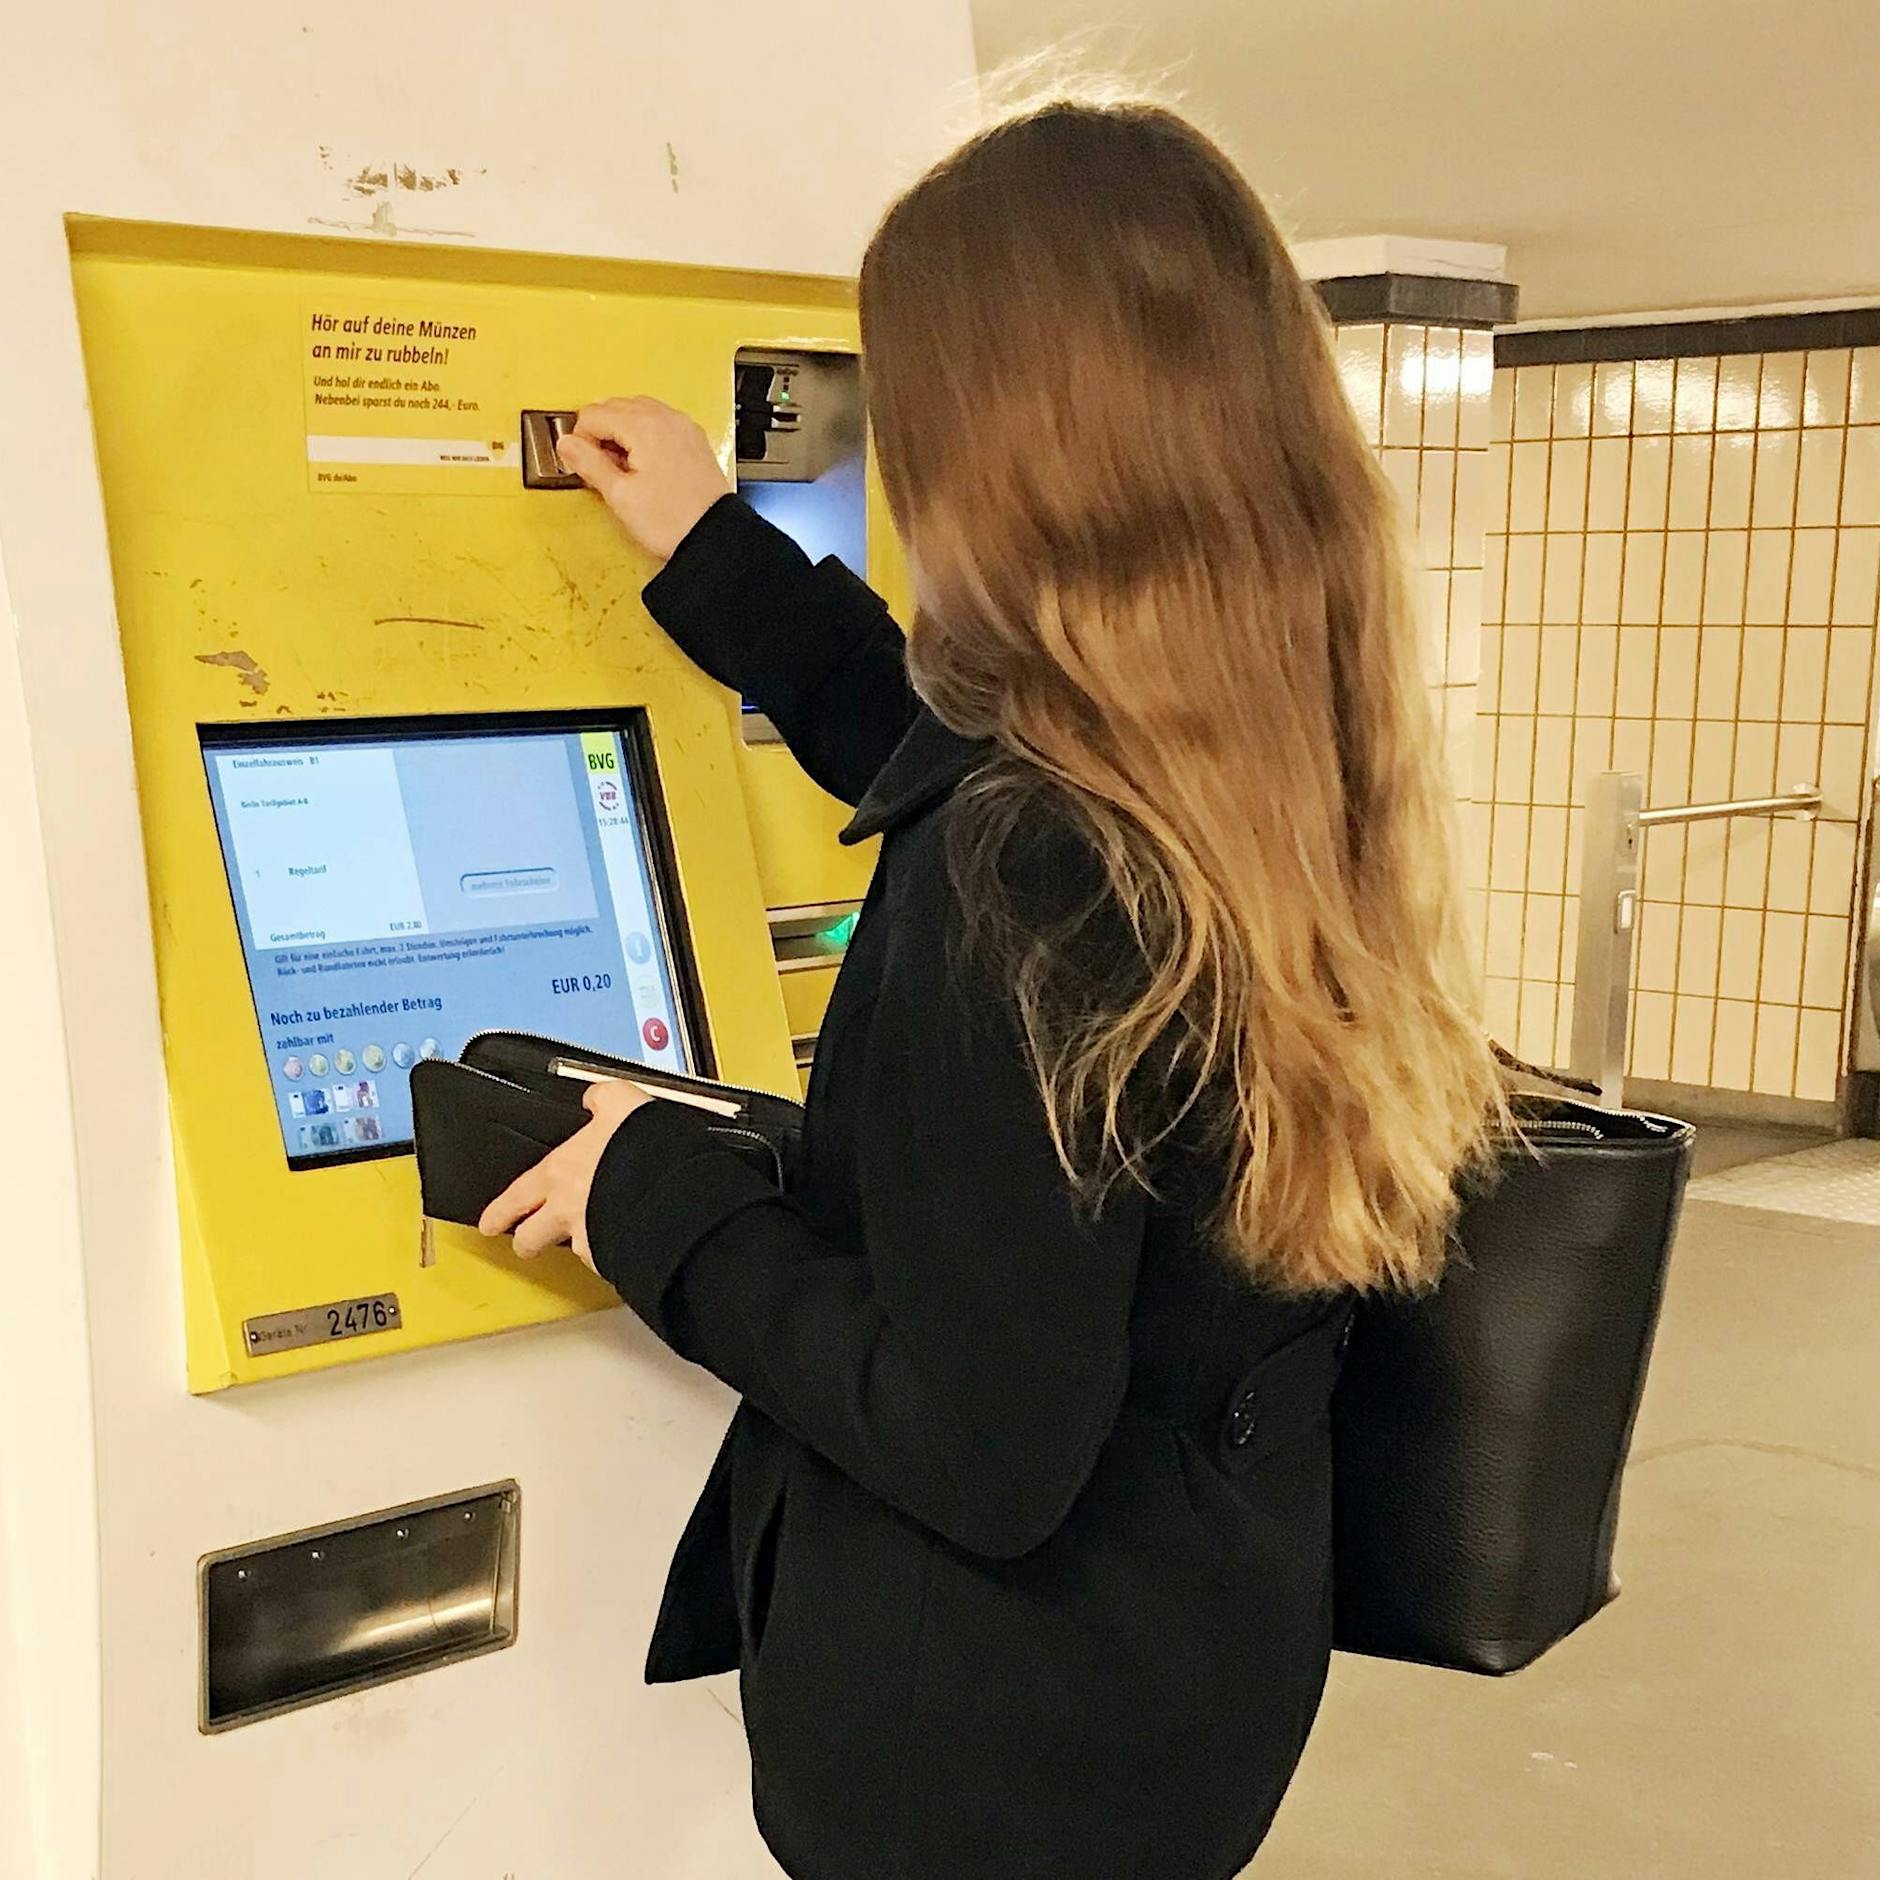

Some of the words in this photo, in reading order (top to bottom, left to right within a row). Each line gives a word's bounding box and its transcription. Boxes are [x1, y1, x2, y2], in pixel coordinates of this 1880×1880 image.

[312, 314, 339, 332] Hör
[343, 316, 370, 334] auf
[373, 317, 415, 337] deine
[419, 320, 477, 340] Münzen
[312, 345, 331, 359] an
[336, 342, 362, 360] mir
[366, 347, 382, 362] zu
[387, 345, 449, 365] rubbeln!
[314, 376, 332, 388] Und
[335, 376, 350, 388] hol
[352, 377, 365, 389] dir
[368, 377, 401, 390] endlich
[404, 379, 418, 391] ein
[315, 393, 361, 406] Nebenbei
[362, 395, 391, 409] sparst
[394, 397, 406, 409] du
[408, 398, 430, 410] noch
[588, 753, 615, 770] BVG
[270, 930, 326, 942] Gesamtbetrag
[552, 977, 580, 994] EUR
[583, 974, 612, 992] 0,20
[270, 1010, 304, 1026] Noch
[307, 1012, 321, 1022] zu
[323, 1000, 399, 1021] bezahlender
[402, 997, 443, 1012] Betrag
[276, 1035, 314, 1050] zahlbar
[317, 1033, 335, 1045] mit
[327, 1301, 388, 1336] 2476
